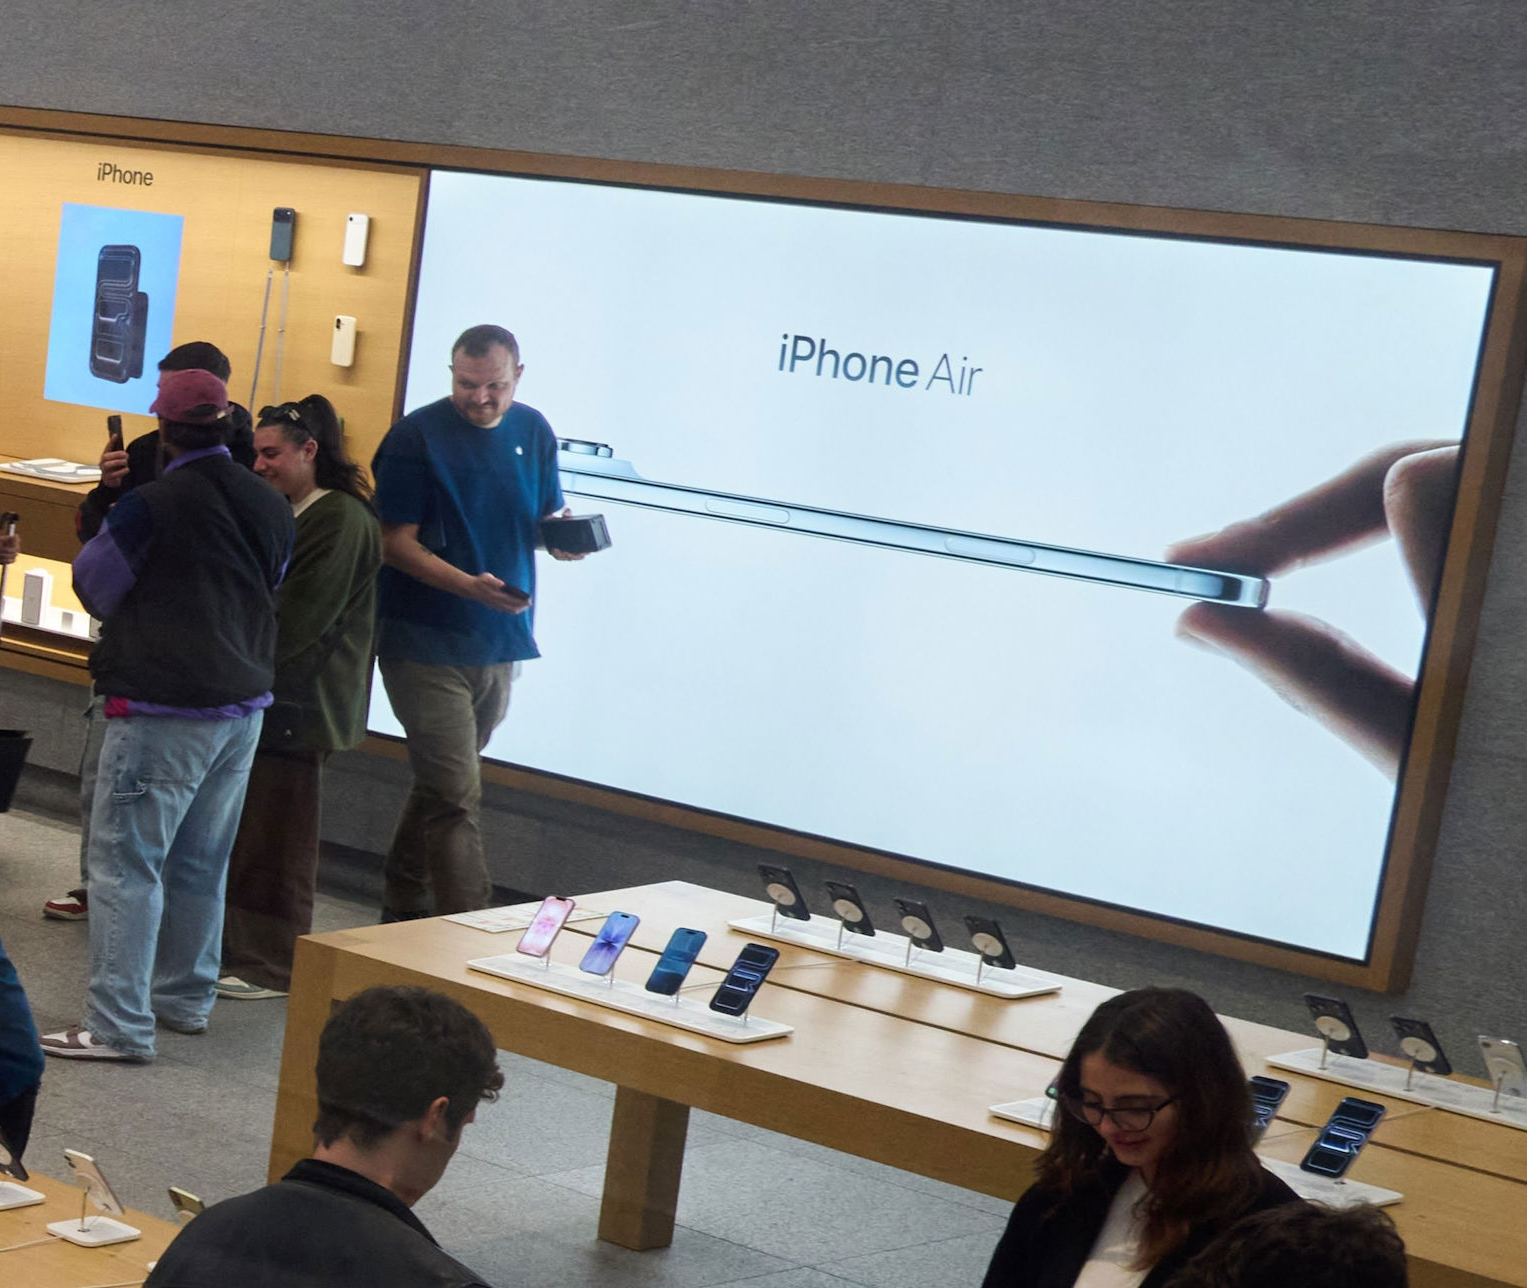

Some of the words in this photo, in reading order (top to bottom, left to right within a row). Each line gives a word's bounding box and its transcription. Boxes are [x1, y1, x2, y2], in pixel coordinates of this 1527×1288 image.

[97, 162, 154, 186] iPhone
[778, 333, 920, 389] iPhone
[924, 353, 984, 396] Air
